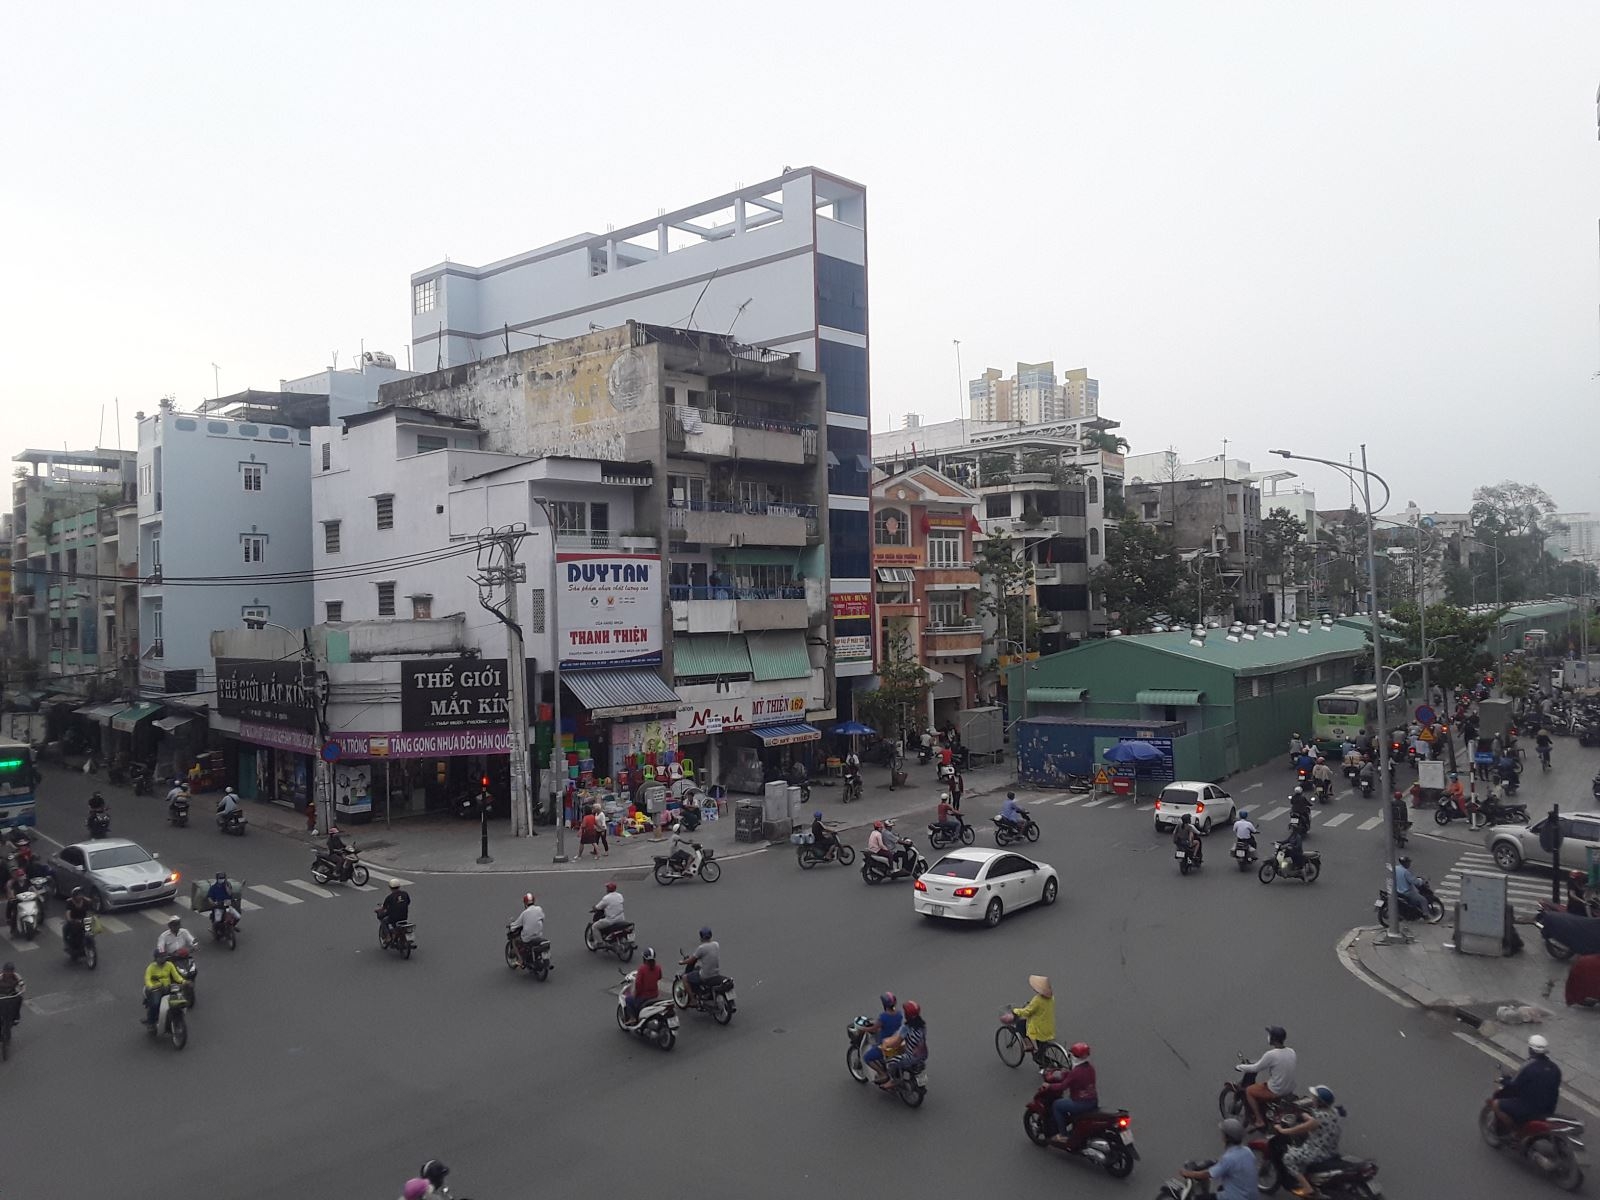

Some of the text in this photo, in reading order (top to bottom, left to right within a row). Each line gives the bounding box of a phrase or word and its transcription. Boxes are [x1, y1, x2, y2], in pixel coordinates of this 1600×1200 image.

[569, 626, 648, 645] THANH THIỆN
[219, 669, 238, 699] THẾ
[239, 672, 259, 702] GIỚI
[261, 671, 283, 704] MẮT
[414, 664, 501, 689] THẾ GIỚI
[431, 691, 510, 716] MẮT KÍN
[767, 695, 789, 715] THIỆN
[790, 698, 804, 711] 162
[391, 734, 412, 757] TẶNG
[413, 736, 437, 756] GỌNG
[437, 735, 459, 754] NHỰA
[461, 731, 476, 750] DẺO
[477, 732, 494, 749] HÀN
